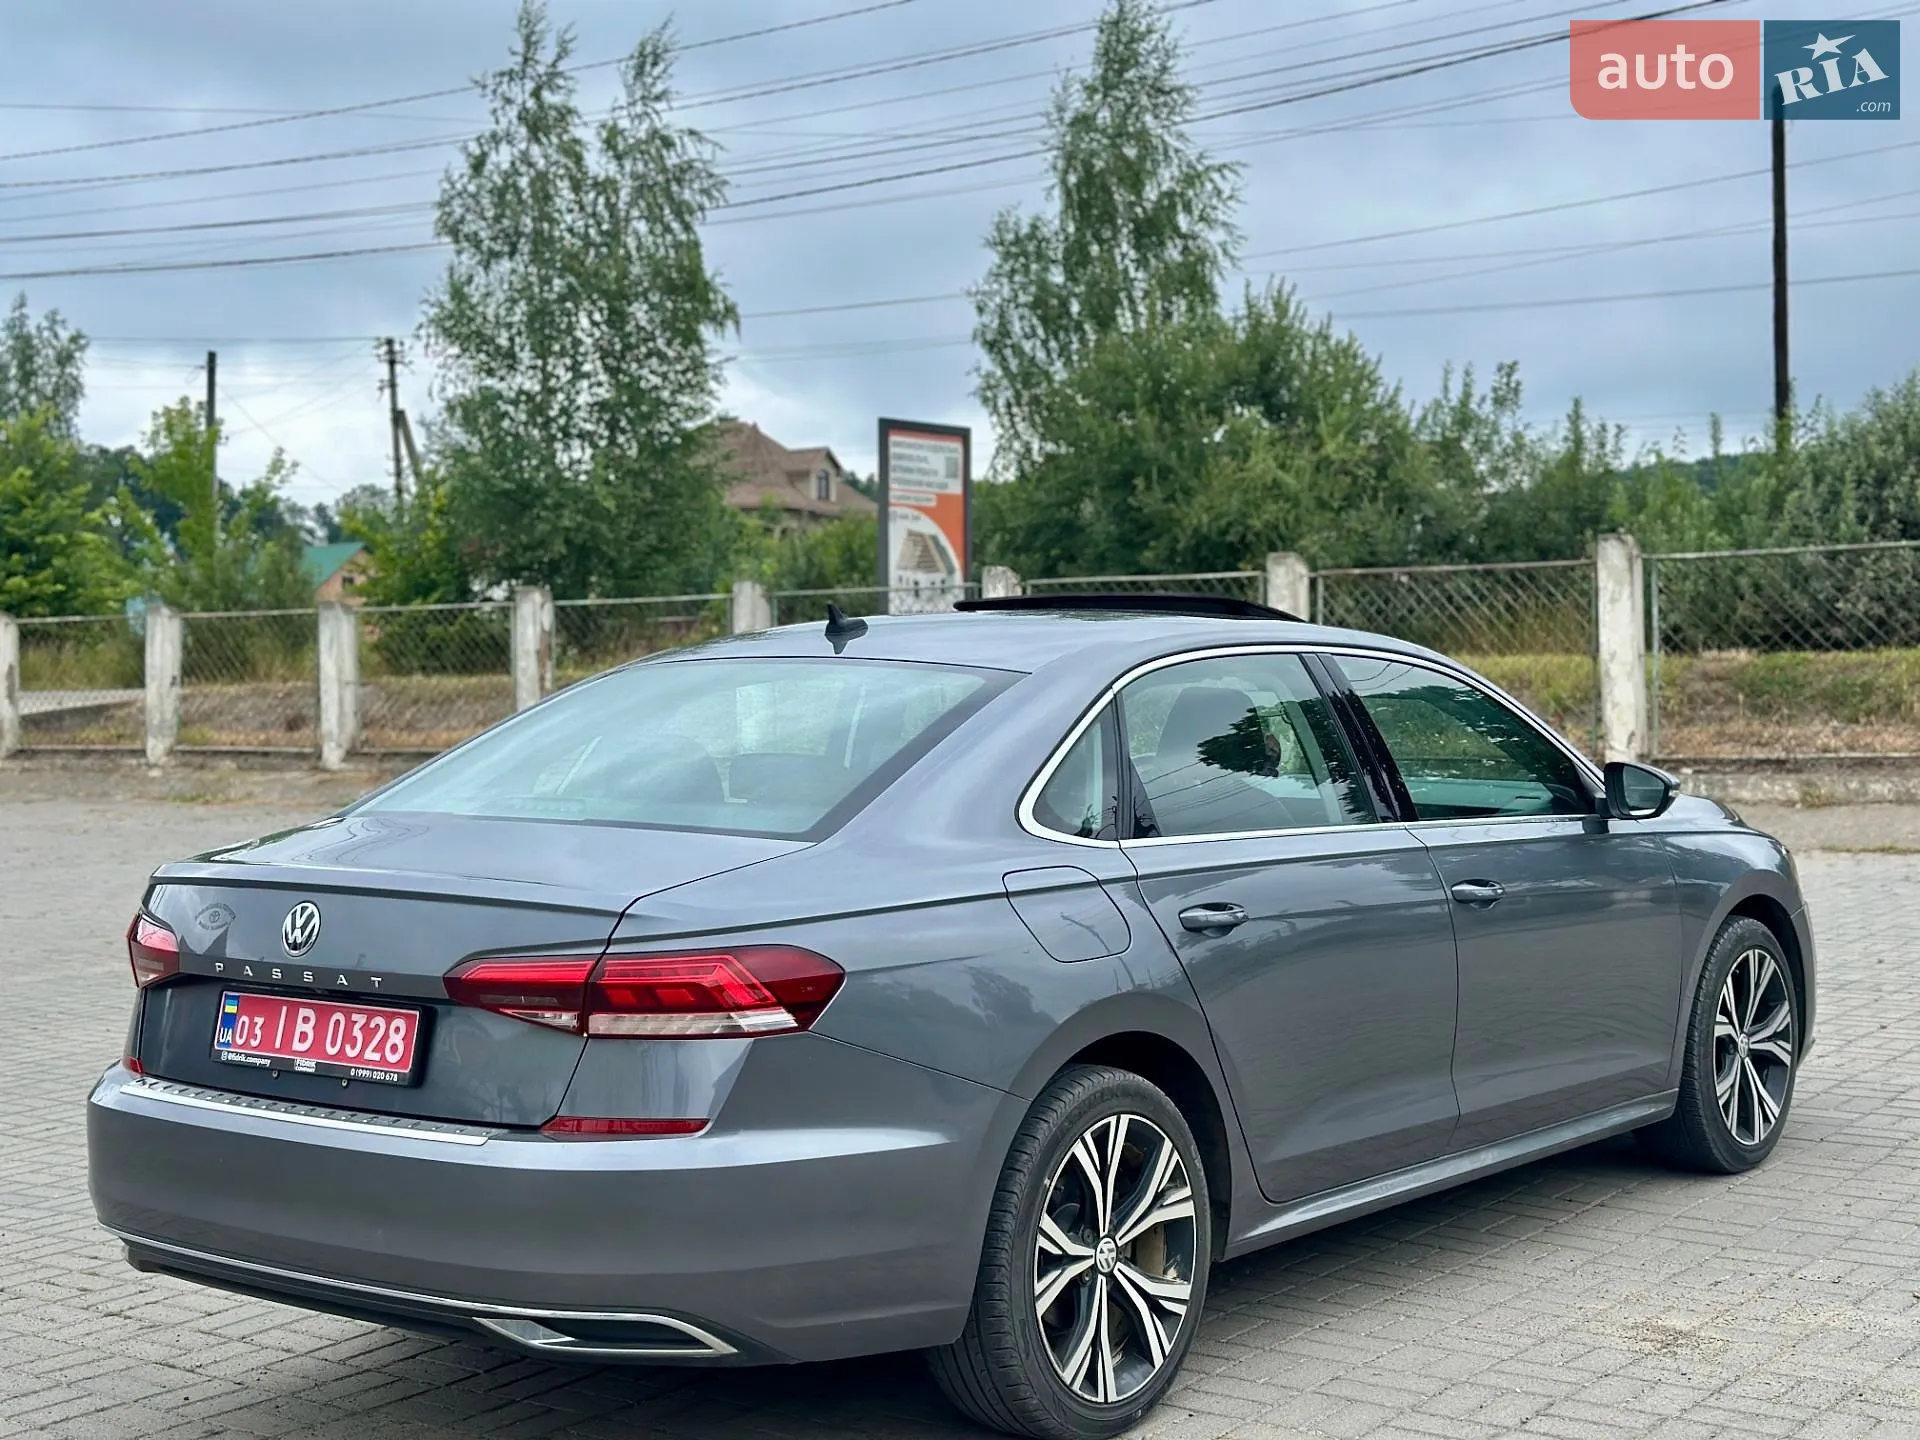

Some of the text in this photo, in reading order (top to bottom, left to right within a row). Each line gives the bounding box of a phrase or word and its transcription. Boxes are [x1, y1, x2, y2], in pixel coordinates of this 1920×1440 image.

[215, 962, 383, 989] PASSAT
[219, 1027, 233, 1044] UA
[235, 1005, 407, 1064] 03 IB 0328
